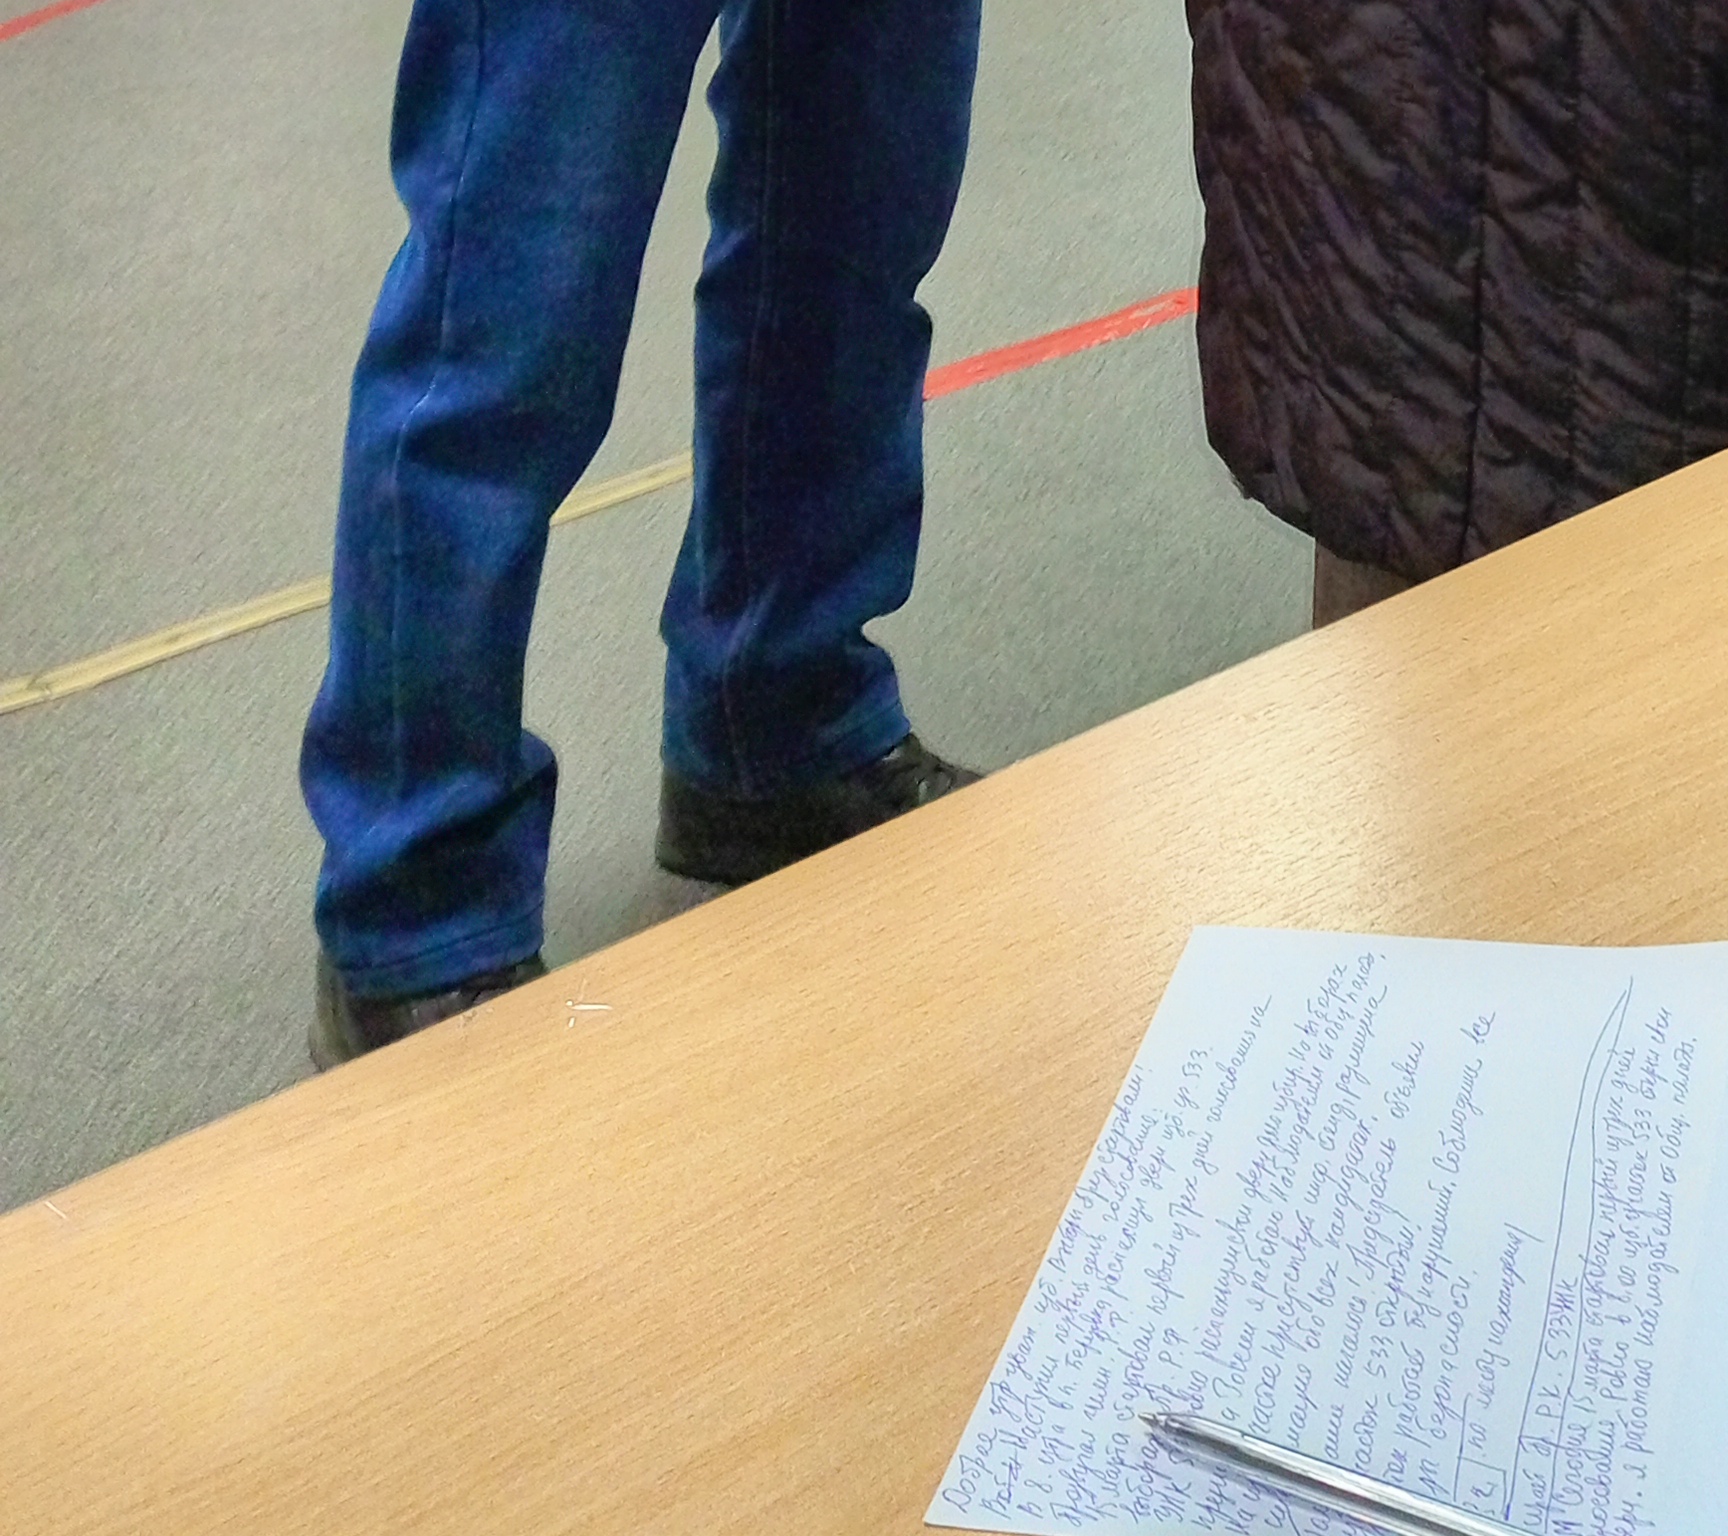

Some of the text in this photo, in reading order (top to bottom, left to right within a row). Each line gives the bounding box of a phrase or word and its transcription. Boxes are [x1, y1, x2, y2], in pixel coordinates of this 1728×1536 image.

[1631, 1108, 1653, 1143] 533
[1137, 1145, 1177, 1191] двери
[1143, 1242, 1186, 1316] первый
[1186, 1129, 1220, 1177] дней
[1205, 1029, 1253, 1123] голосования
[1249, 996, 1272, 1029] на
[1082, 1233, 1108, 1277] день
[1362, 1334, 1395, 1379] 533
